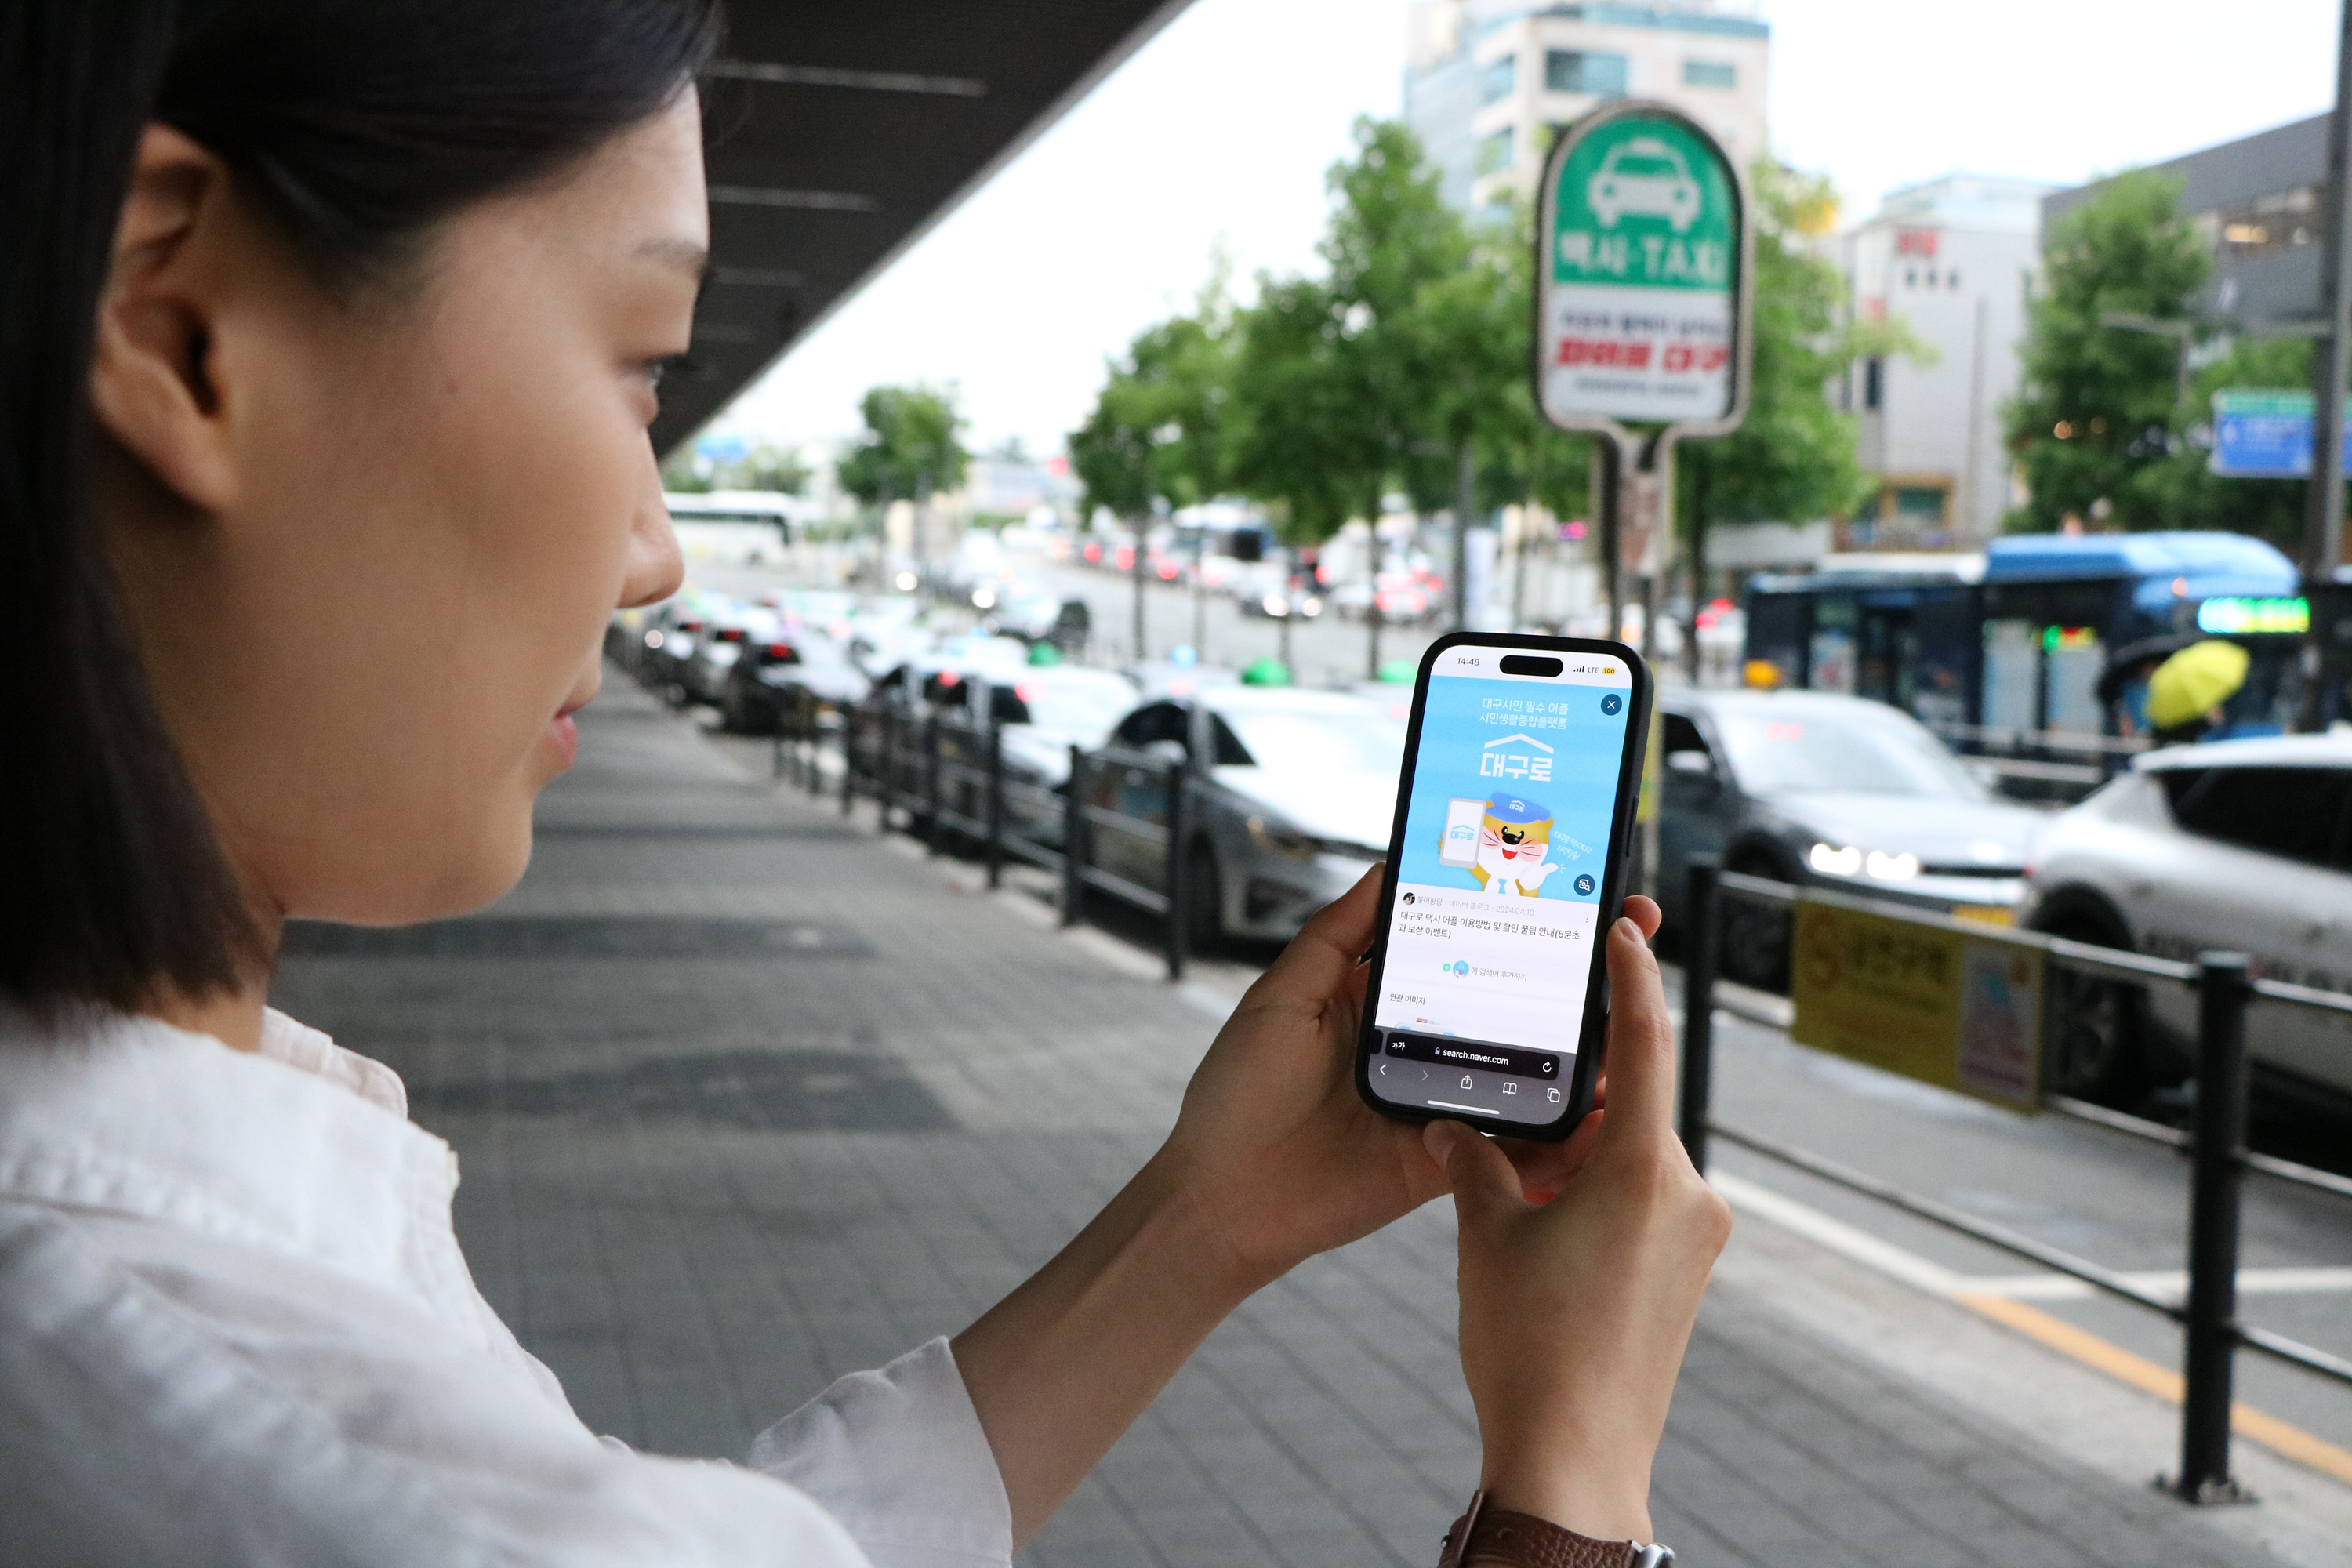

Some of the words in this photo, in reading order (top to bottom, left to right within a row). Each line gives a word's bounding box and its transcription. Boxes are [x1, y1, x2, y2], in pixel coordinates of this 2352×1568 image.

[1457, 657, 1480, 666] 14:48
[1482, 698, 1523, 712] 대구시민
[1525, 701, 1545, 713] 필수
[1548, 702, 1569, 716] 어플
[1479, 712, 1568, 730] 시민생활종합플랫폼
[1479, 753, 1553, 782] 대구로
[1509, 803, 1525, 813] 대구로
[1450, 830, 1474, 841] 대구로
[1554, 831, 1570, 844] 대구로
[1449, 900, 1468, 909] 네이버
[1470, 902, 1490, 911] 블로그
[1496, 906, 1536, 916] 2024.04.10.
[1399, 924, 1406, 933] 과
[1407, 925, 1423, 935] 보상
[1425, 927, 1452, 939] 이벤트)
[1400, 911, 1424, 921] 대구로
[1425, 914, 1441, 924] 택시
[1443, 916, 1458, 927] 어플
[1460, 918, 1491, 931] 이용방법
[1494, 921, 1501, 931] 및
[1503, 922, 1519, 934] 할인
[1521, 924, 1537, 936] 꿀팁
[1538, 927, 1580, 940] 안내(5분초
[1471, 967, 1478, 975] 에
[1479, 967, 1500, 978] 검색어
[1501, 971, 1528, 982] 추가하기
[1389, 993, 1403, 1003] 연관
[1405, 995, 1425, 1006] 이미지
[1443, 1049, 1509, 1065] search.naver.com
